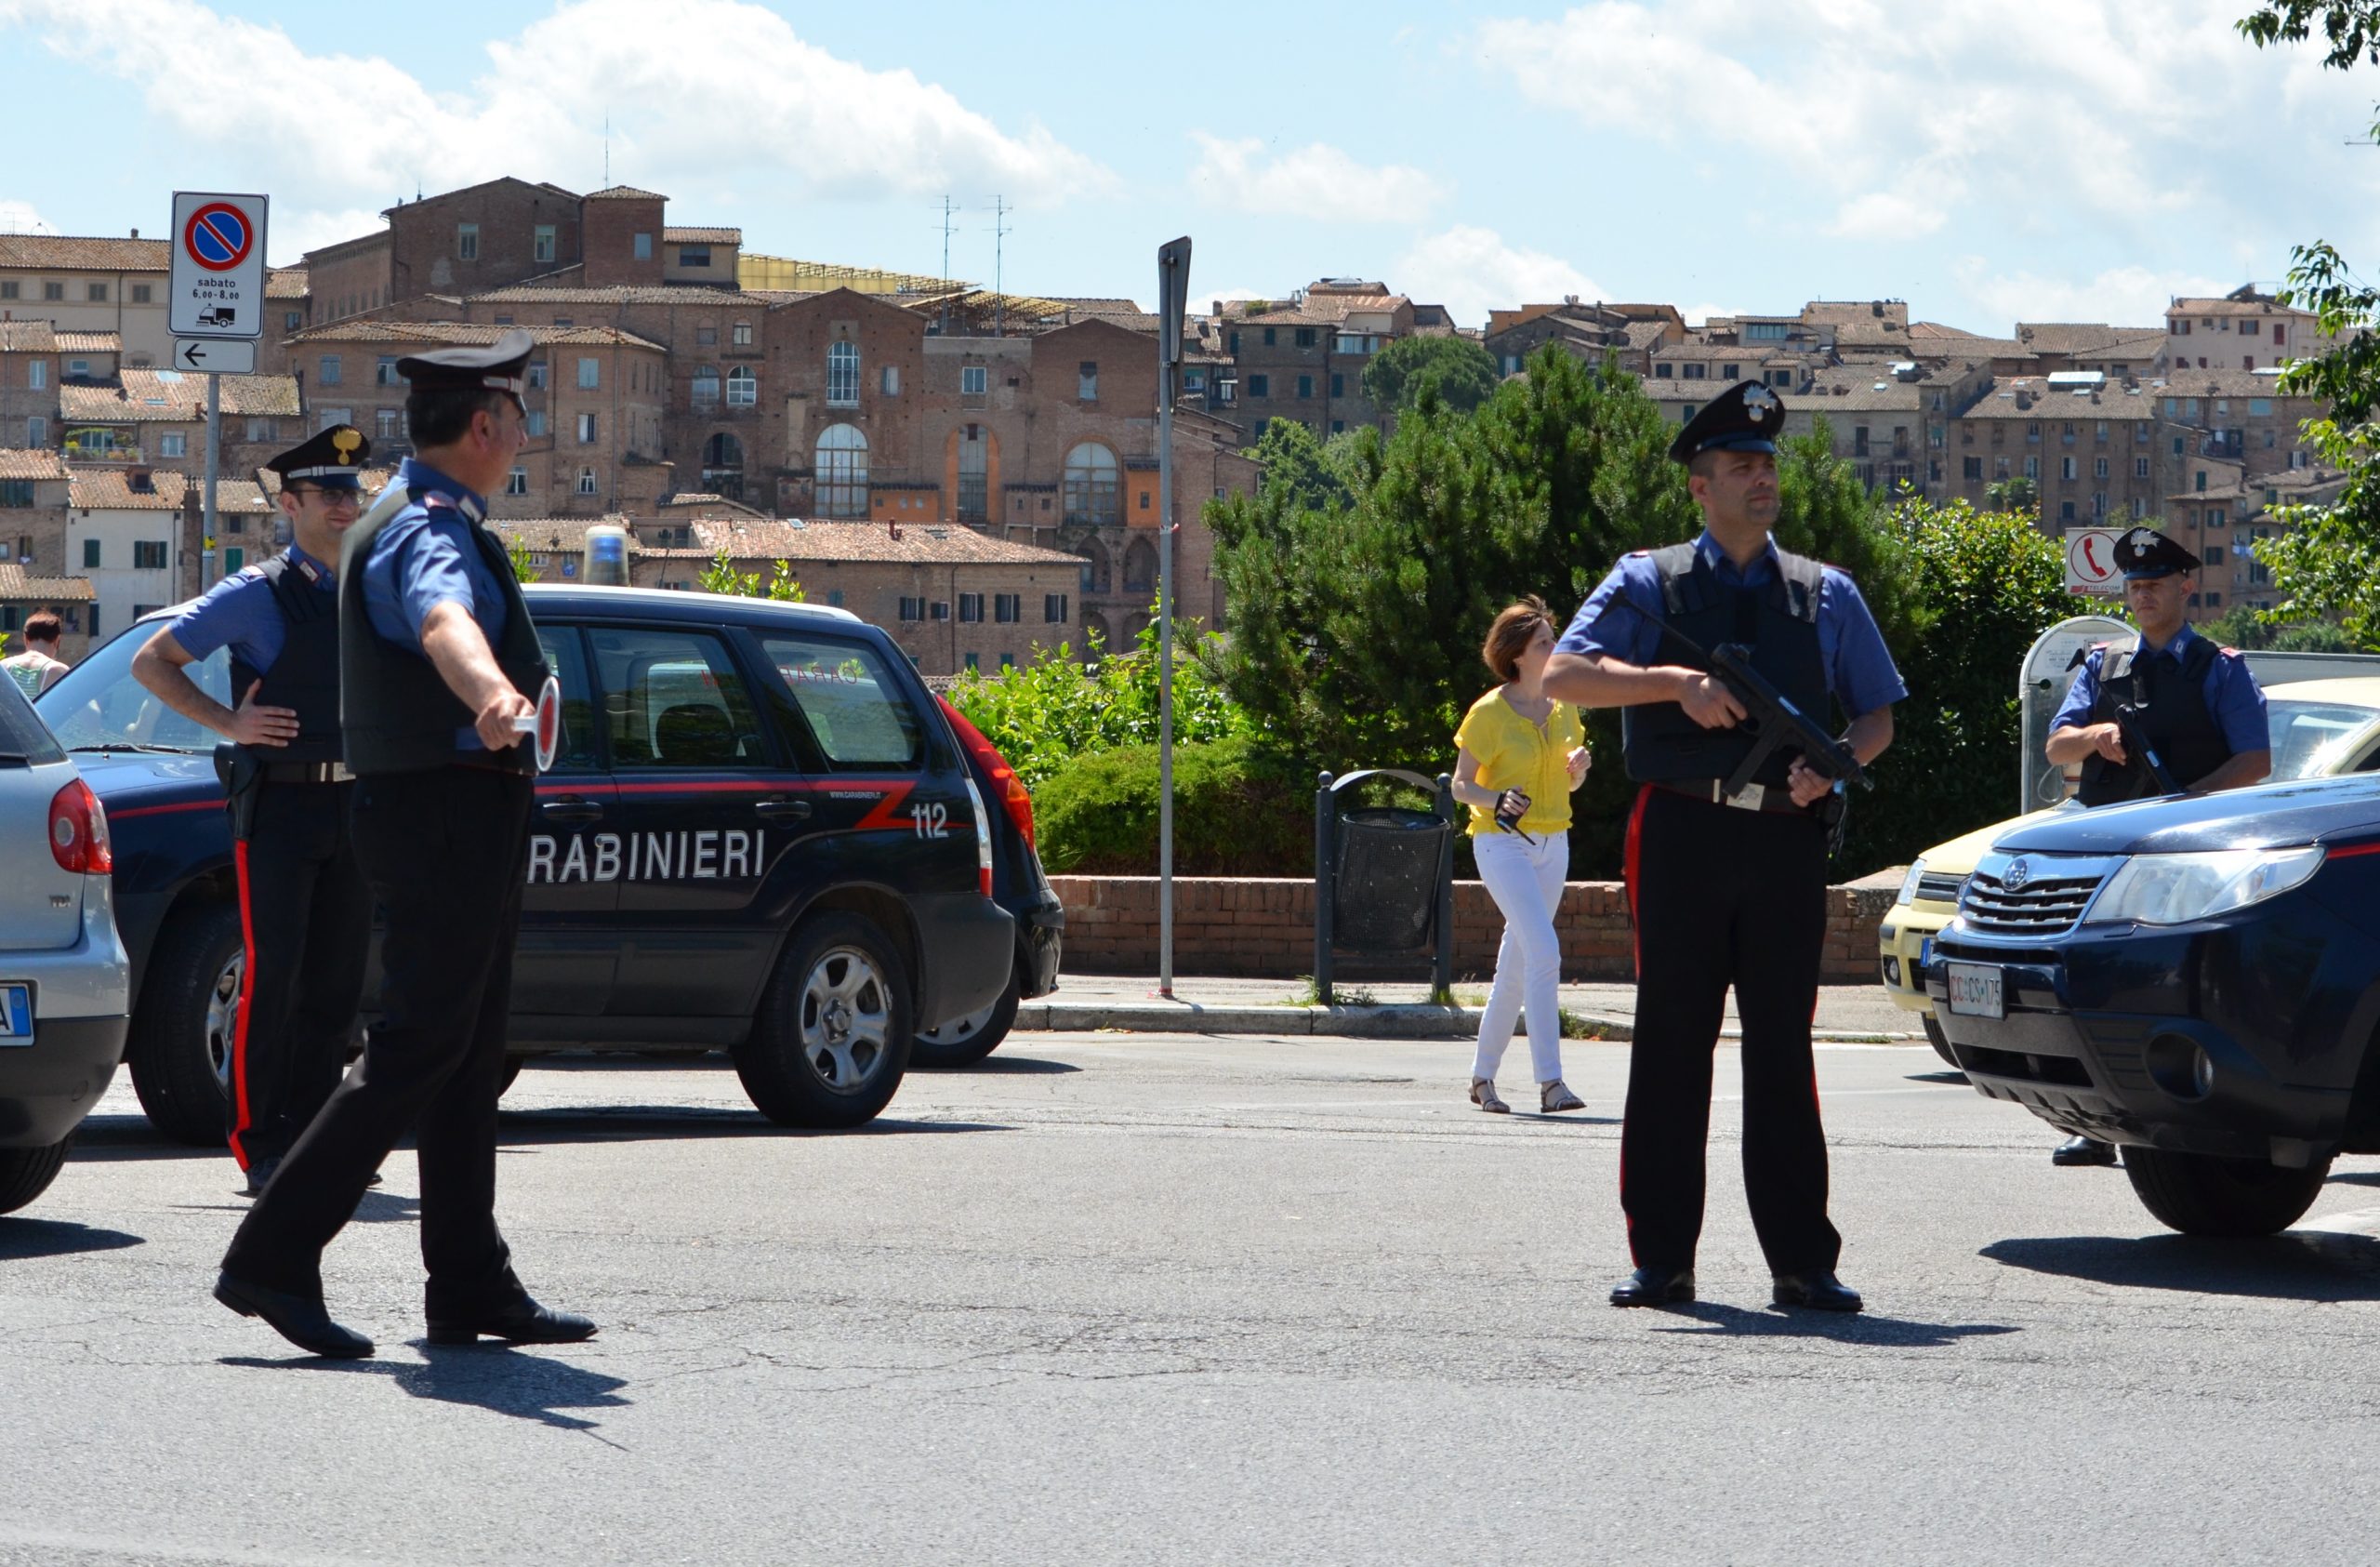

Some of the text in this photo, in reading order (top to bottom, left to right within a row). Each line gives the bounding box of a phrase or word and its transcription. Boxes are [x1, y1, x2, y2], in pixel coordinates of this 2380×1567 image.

[198, 277, 236, 288] sabato
[910, 802, 949, 839] 112
[526, 829, 764, 883] RABINIERI
